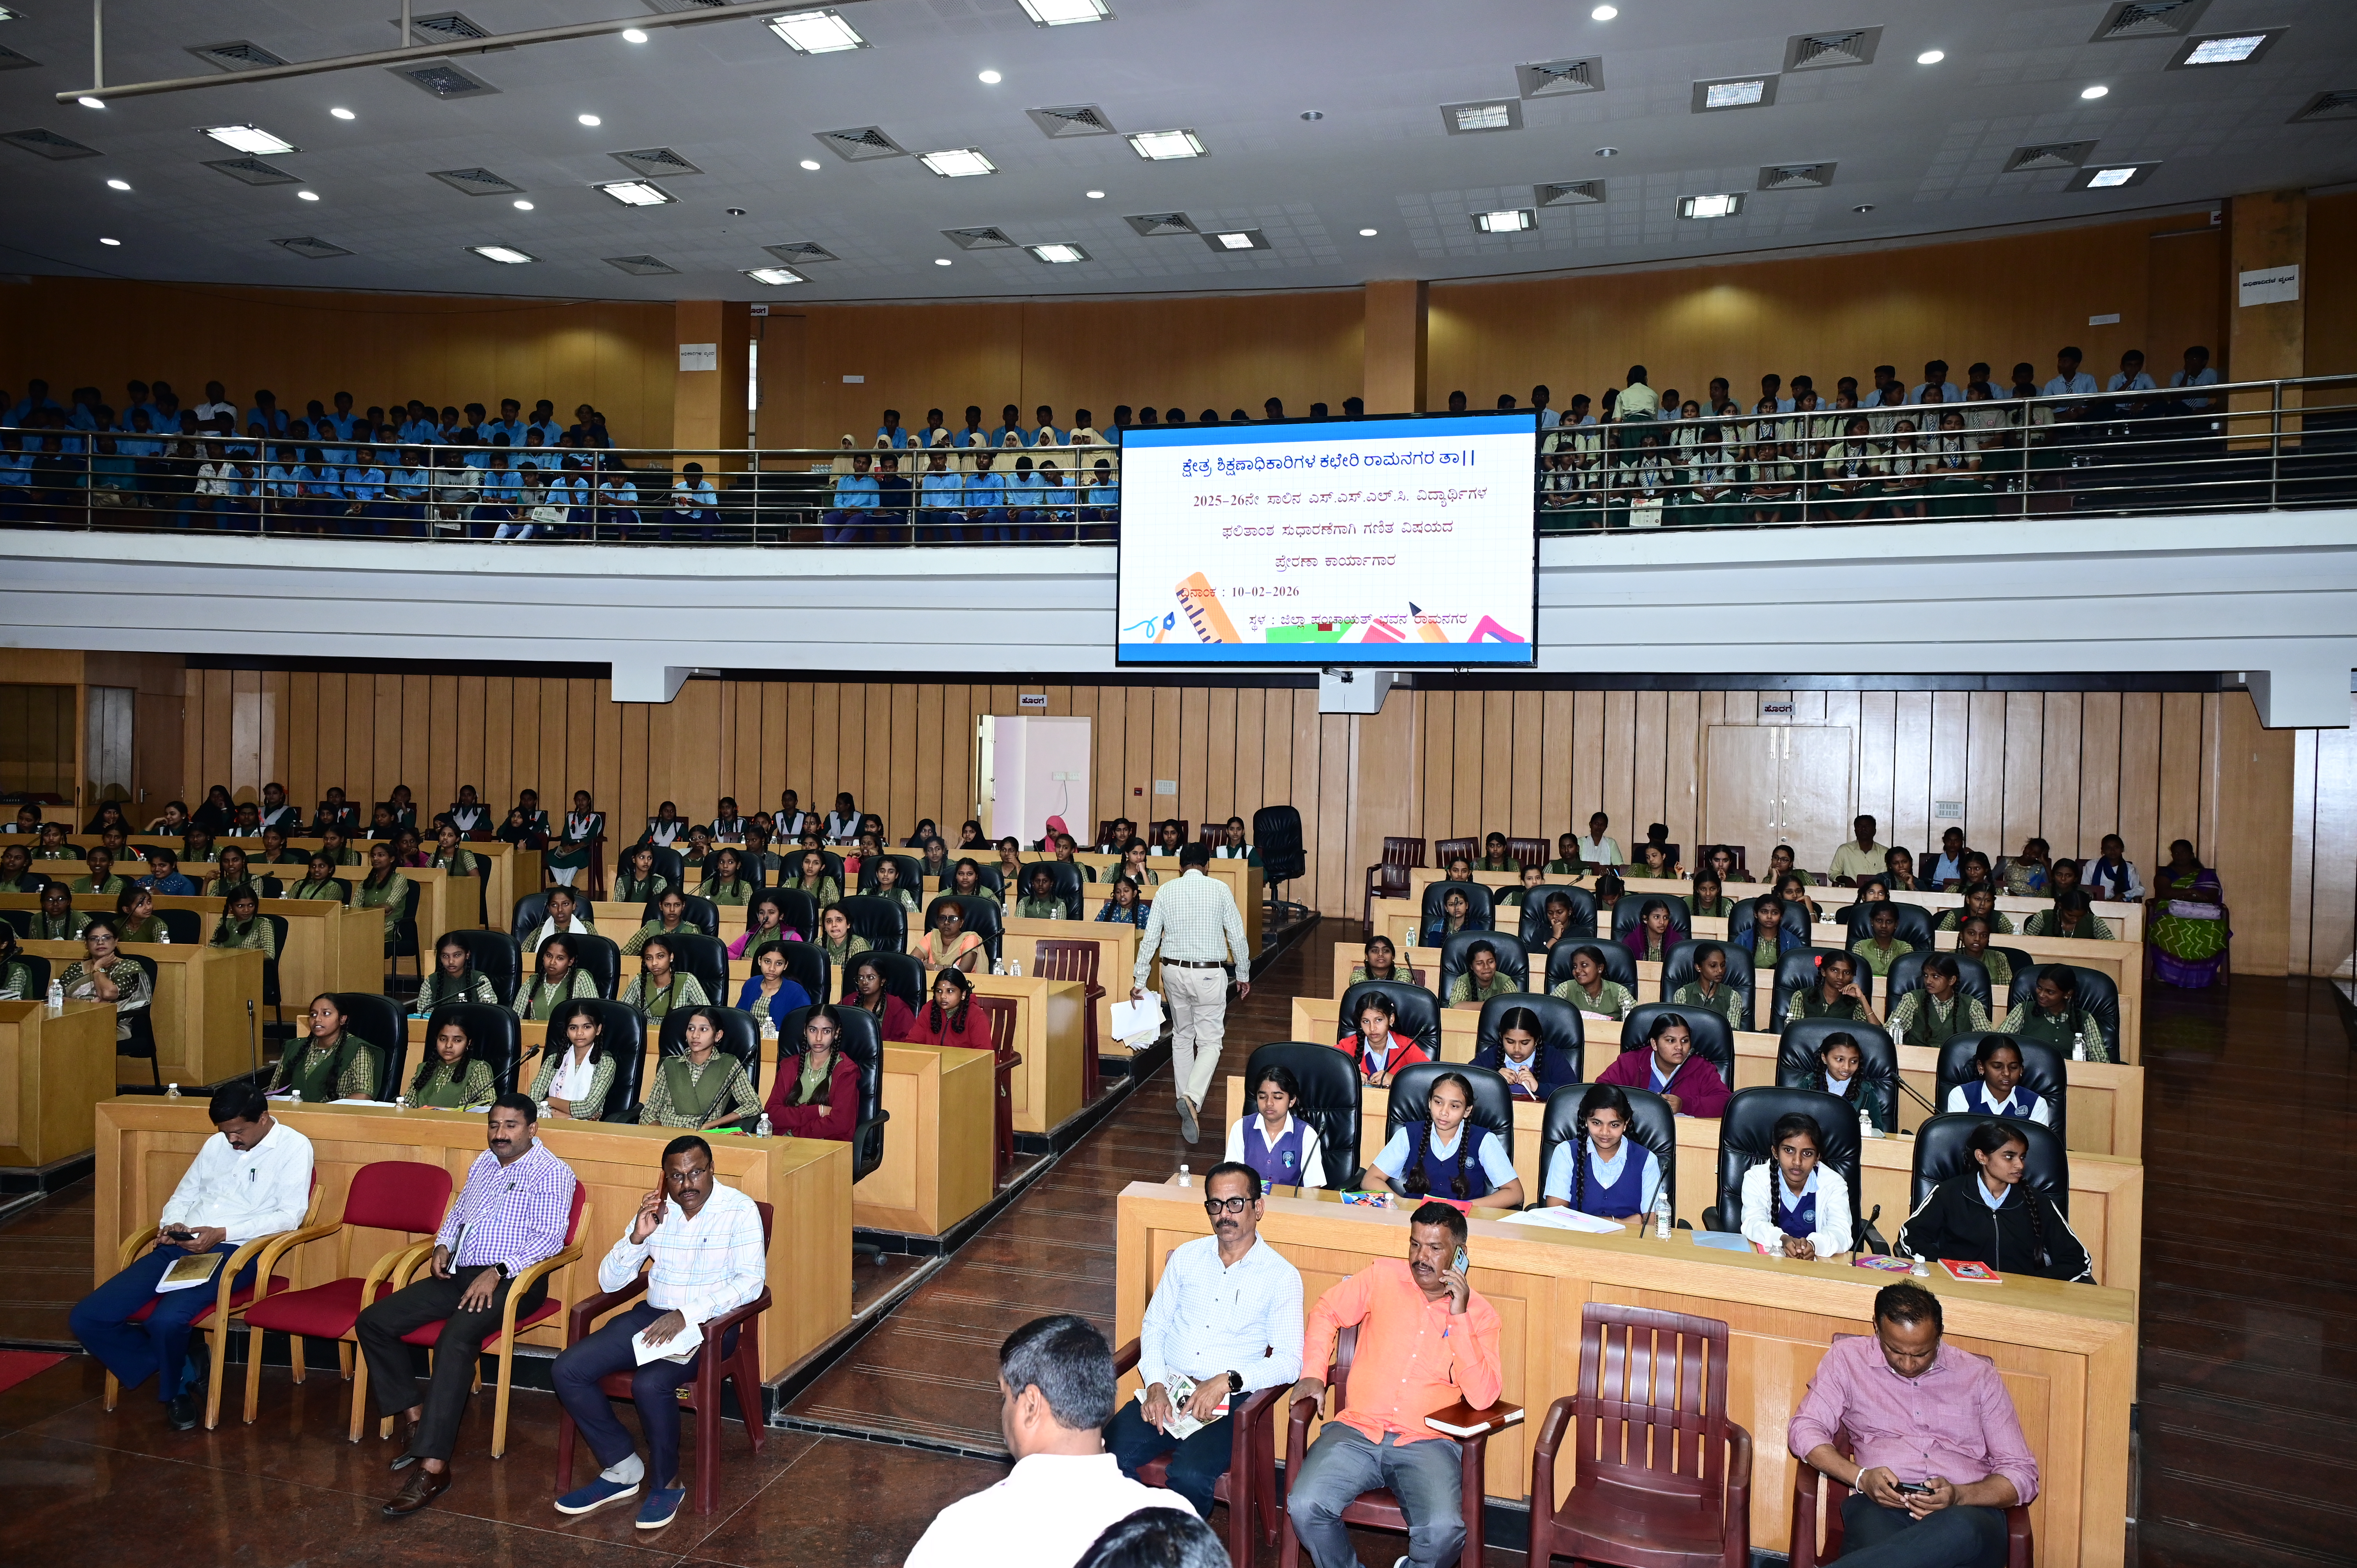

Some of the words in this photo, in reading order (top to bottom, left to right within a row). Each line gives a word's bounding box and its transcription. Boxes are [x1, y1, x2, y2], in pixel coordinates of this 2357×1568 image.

[1182, 458, 1212, 477] ಕ್ಷೇತ್ರ
[1217, 454, 1316, 476] ಶಿಕ್ಷಣಾಧಿಕಾರಿಗಳ
[1320, 453, 1359, 469] ಕಛೇರಿ
[1364, 450, 1434, 466] ರಾಮನಗರ
[1193, 493, 1259, 507] 2025-26ನೇ
[1267, 492, 1302, 505] ಸಾಲಿನ
[1309, 490, 1409, 505] ಎಸ್.ಎಸ್.ಎಲ್.ಸಿ.
[1416, 487, 1488, 507] ವಿದ್ಯಾರ್ಥಿಗಳ
[1222, 524, 1274, 539] ಫಲಿತಾಂಶ
[1282, 522, 1356, 538] ಸುಧಾರಣೆಗಾಗಿ
[1364, 520, 1394, 534] ಗಣಿತ
[1401, 519, 1453, 534] ವಿಷಯದ
[1275, 554, 1318, 572] ಪ್ರೇರಣಾ
[1325, 553, 1396, 567] ಕಾರ್ಯಾಗಾರ
[1180, 586, 1217, 598] ದಿನಾಂಕ
[1232, 586, 1299, 597] 10-02-2026
[1249, 614, 1266, 632] ಸ್ಥಳ
[1281, 614, 1306, 630] ಜಿಲ್ಲಾ
[1311, 613, 1373, 624] ಪಂಚಾಯತ್
[1379, 613, 1408, 627] ಭವನ
[1413, 613, 1468, 624] ರಾಮನಗರ
